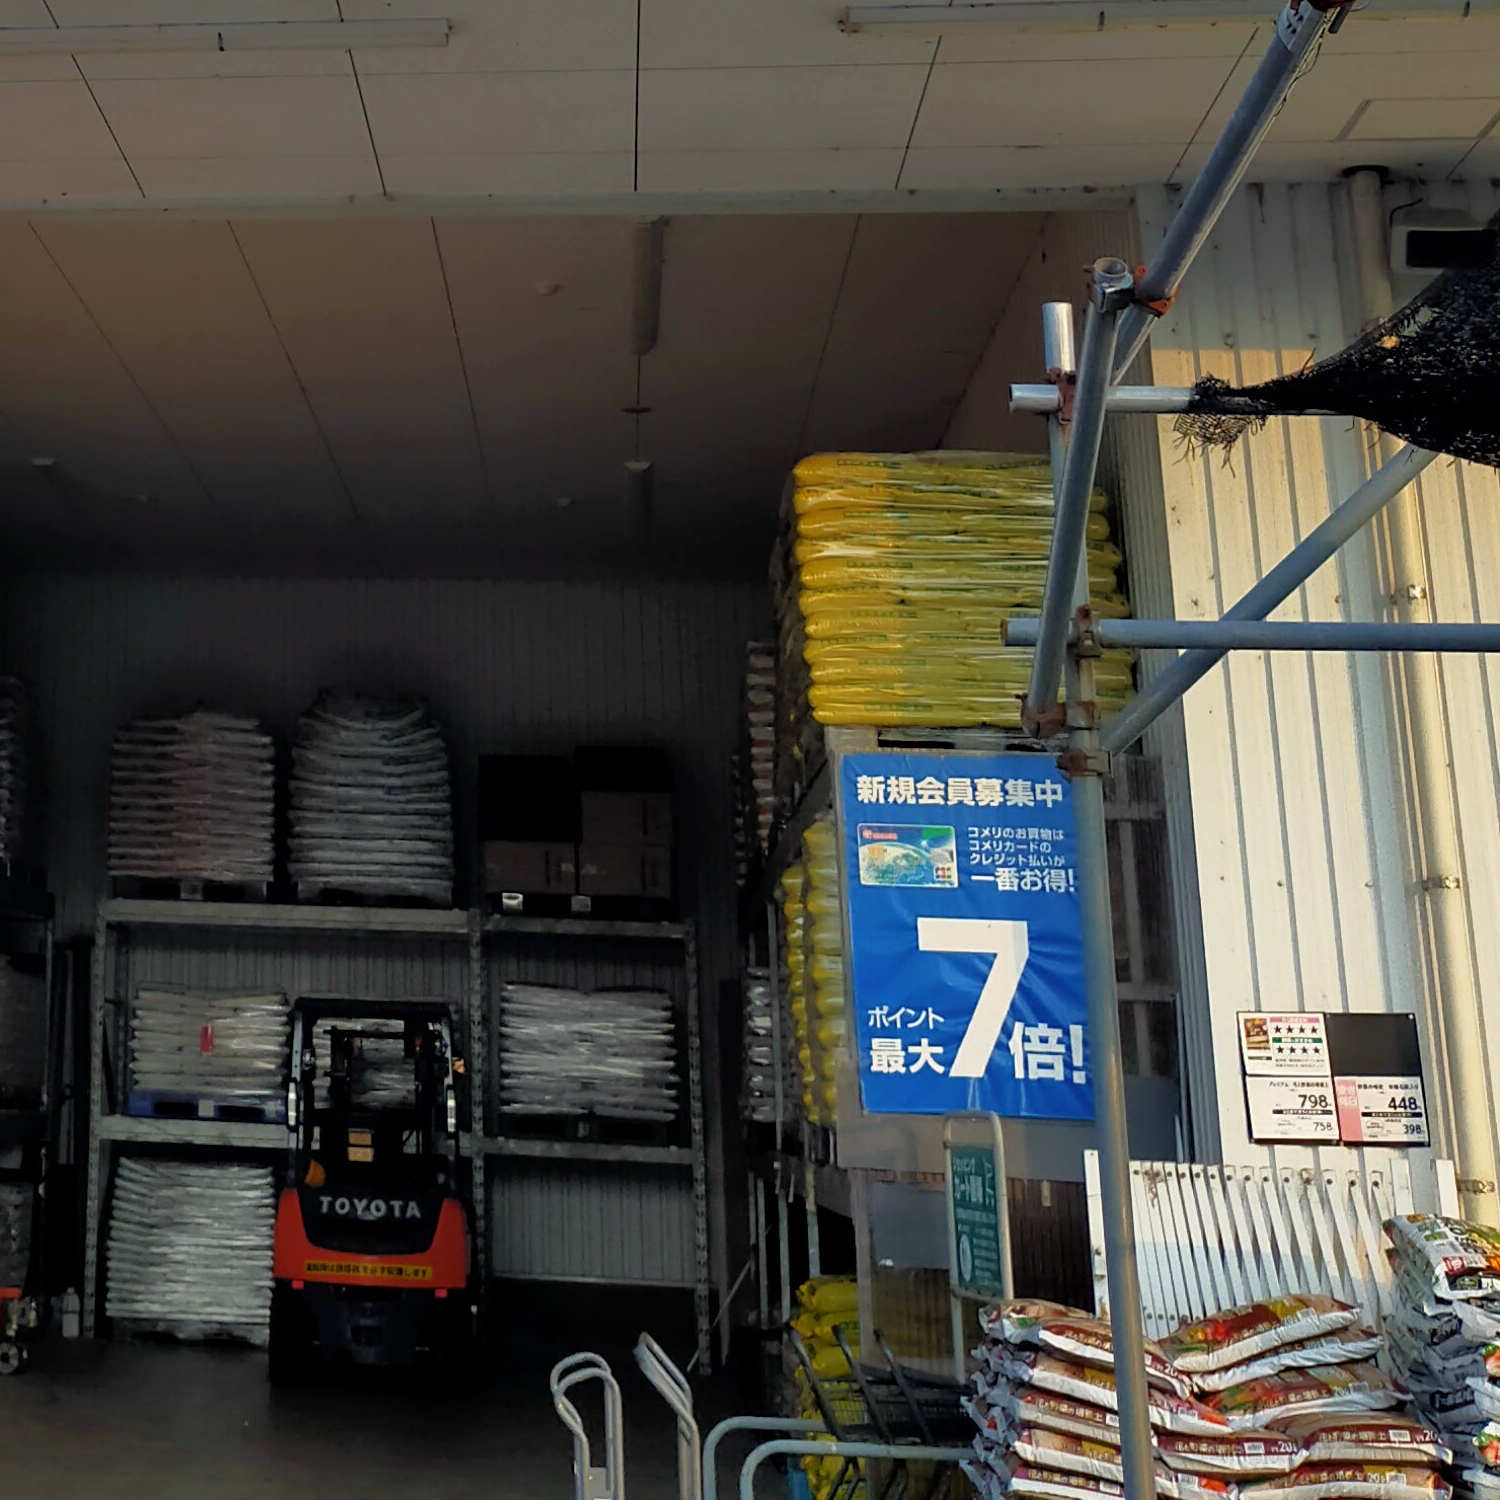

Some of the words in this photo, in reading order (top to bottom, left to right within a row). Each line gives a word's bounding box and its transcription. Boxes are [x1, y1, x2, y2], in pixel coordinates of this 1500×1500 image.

[856, 775, 1063, 808] 新規会員募集中
[967, 826, 1065, 841] コメリのお買物は
[968, 840, 1052, 853] コメリカードの
[969, 853, 1066, 867] クレジット払いが
[870, 1038, 946, 1075] 最大
[916, 916, 1030, 1078] 7
[867, 1005, 945, 1029] ポイント
[1298, 1094, 1329, 1108] 798
[1388, 1096, 1418, 1111] 448
[1313, 1121, 1333, 1131] 758
[1402, 1123, 1422, 1135] 398
[319, 1195, 422, 1219] TOYOTA
